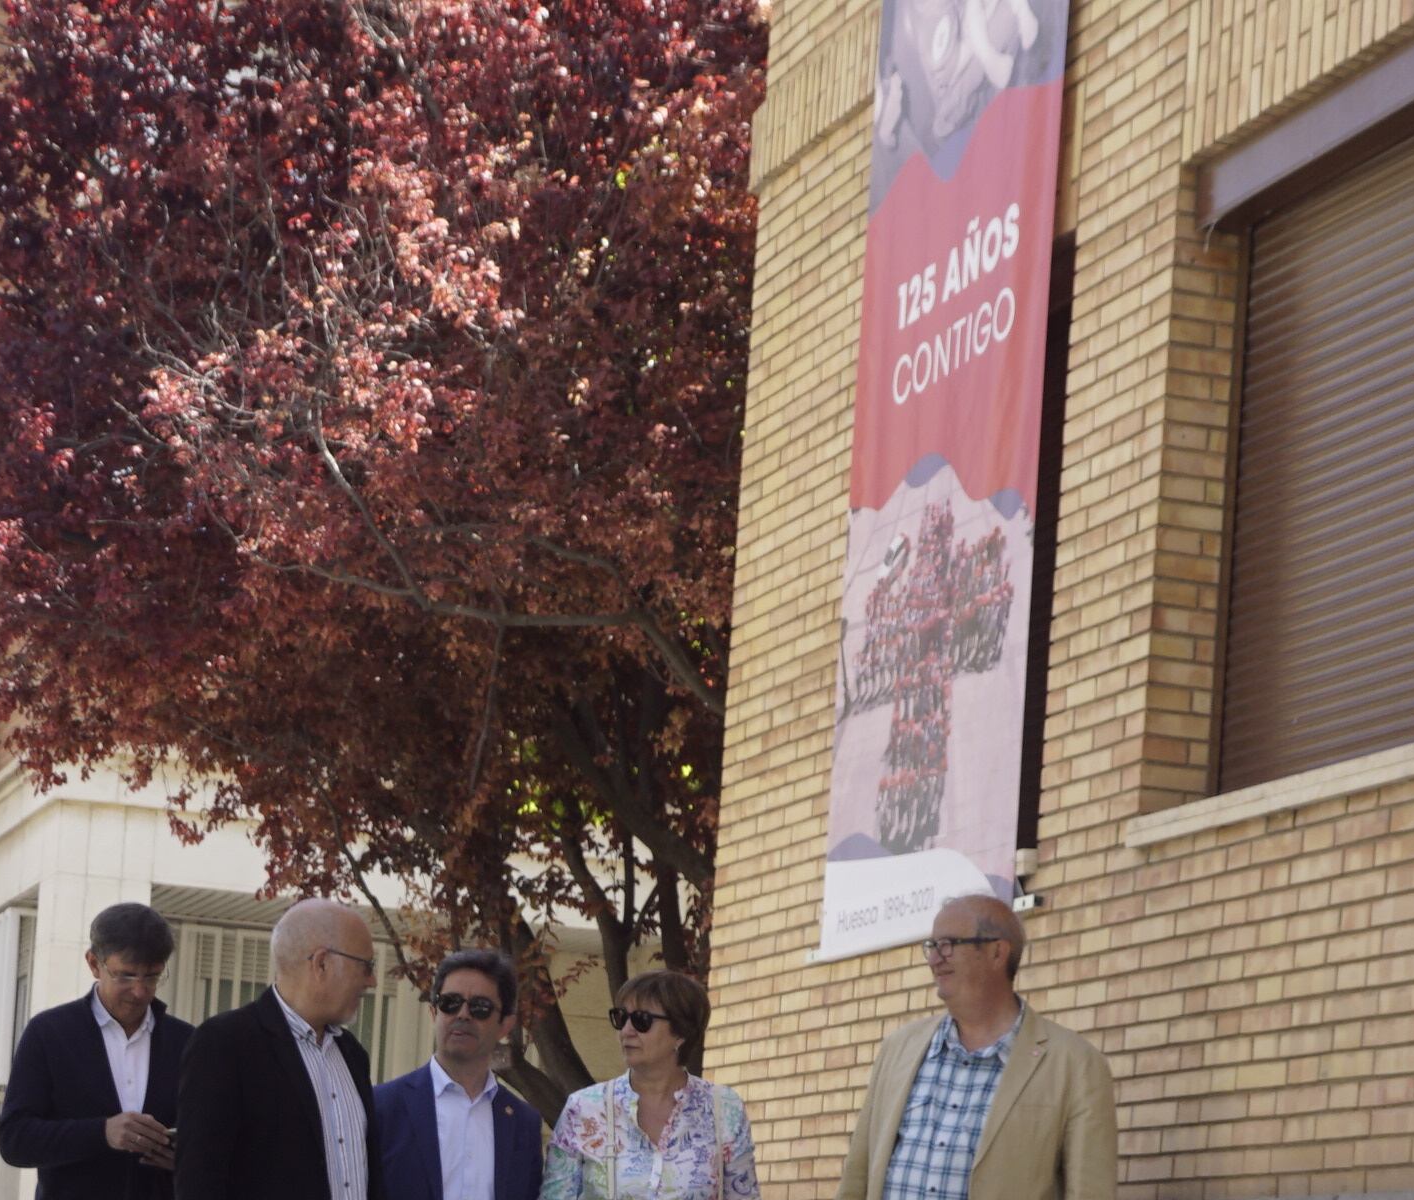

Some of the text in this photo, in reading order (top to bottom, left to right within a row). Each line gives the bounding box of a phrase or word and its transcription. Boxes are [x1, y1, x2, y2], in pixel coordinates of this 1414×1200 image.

[898, 203, 1020, 330] 125 AÑOS
[892, 287, 1016, 405] CONTIGO
[836, 886, 934, 934] Huesca 1896-2021
